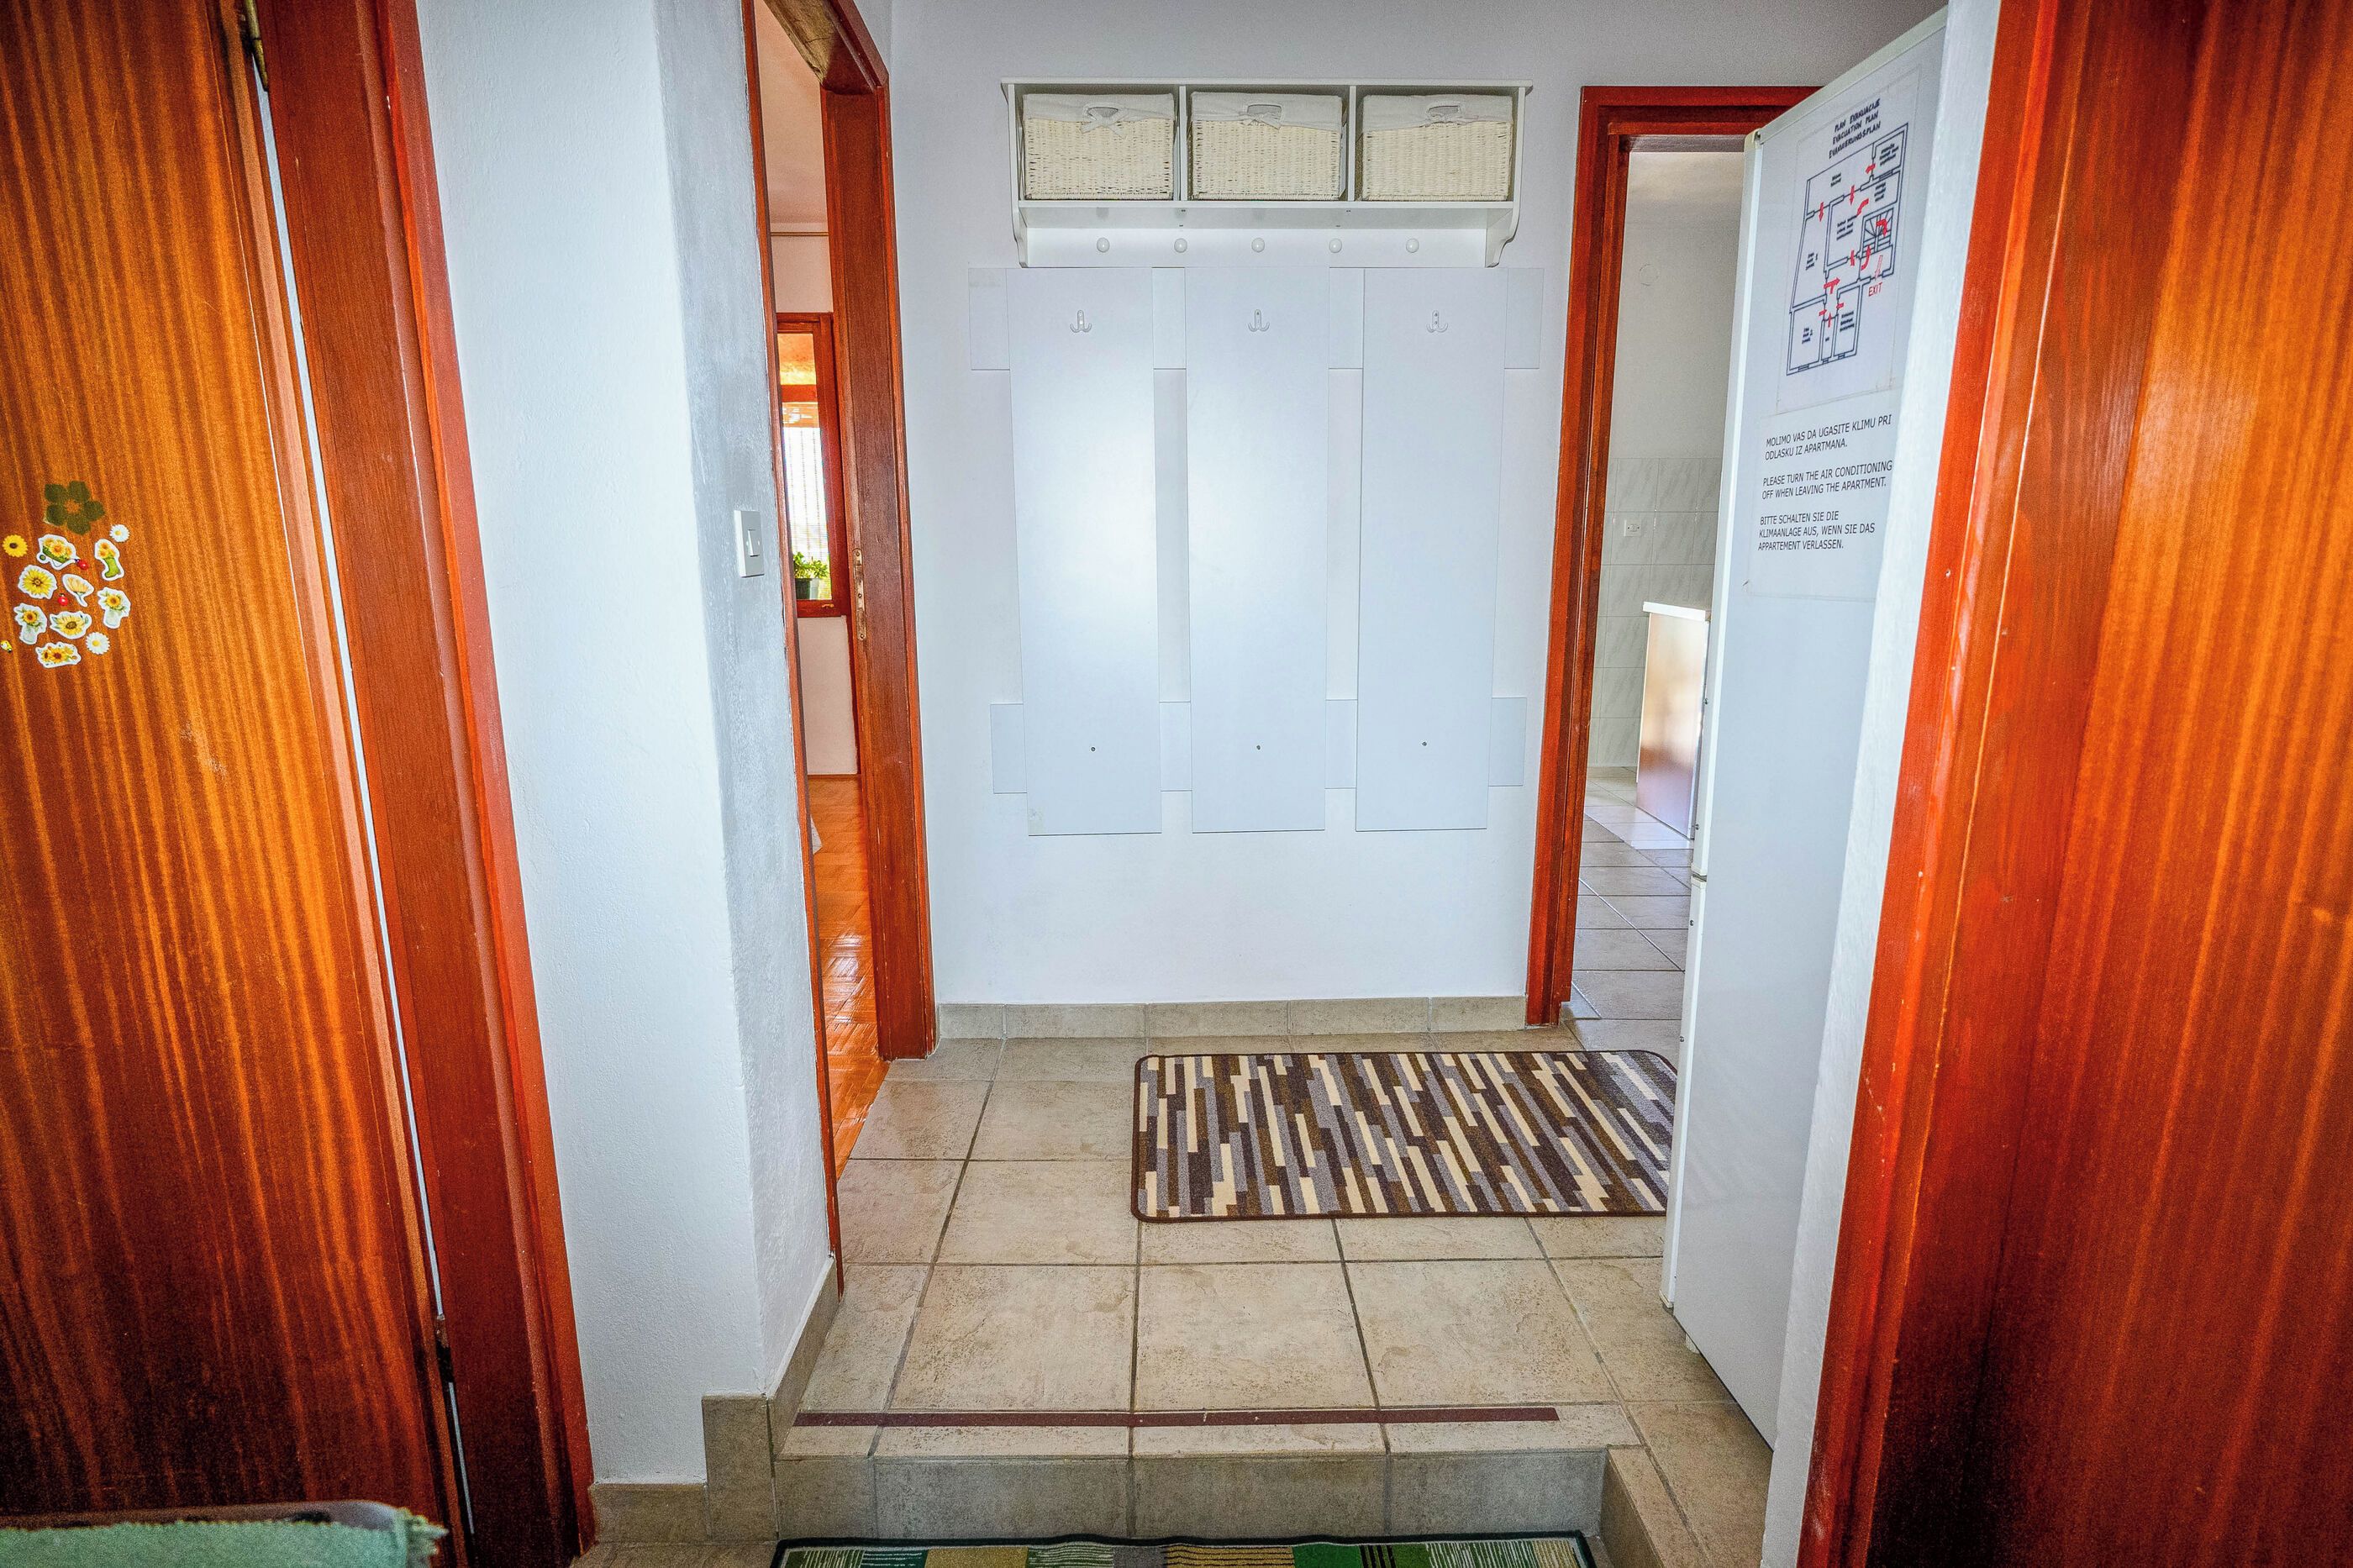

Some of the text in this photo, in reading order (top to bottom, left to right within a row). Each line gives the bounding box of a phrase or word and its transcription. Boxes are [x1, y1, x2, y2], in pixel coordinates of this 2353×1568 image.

[1833, 110, 1878, 144] EVACUATION PLAN
[1834, 120, 1845, 132] PLAN
[1869, 282, 1882, 297] EXIT
[1766, 414, 1892, 447] MOLIMO VAS DA UGASITE KLIMU PRI
[1765, 439, 1847, 460] ODLASKU IZ APARTMANA.
[1763, 460, 1892, 487] PLEASE TURN THE AIR CONDITIONING
[1762, 476, 1886, 499] OFF WHEN LEAVING THE APARTMENT.
[1761, 511, 1839, 525] BITTE SCHALTEN SIE DIE
[1759, 523, 1875, 538] KLIMAANLAGE AUS, WENN SIE DAS
[1758, 539, 1844, 550] APPARTEMENT VERLASSEN.
